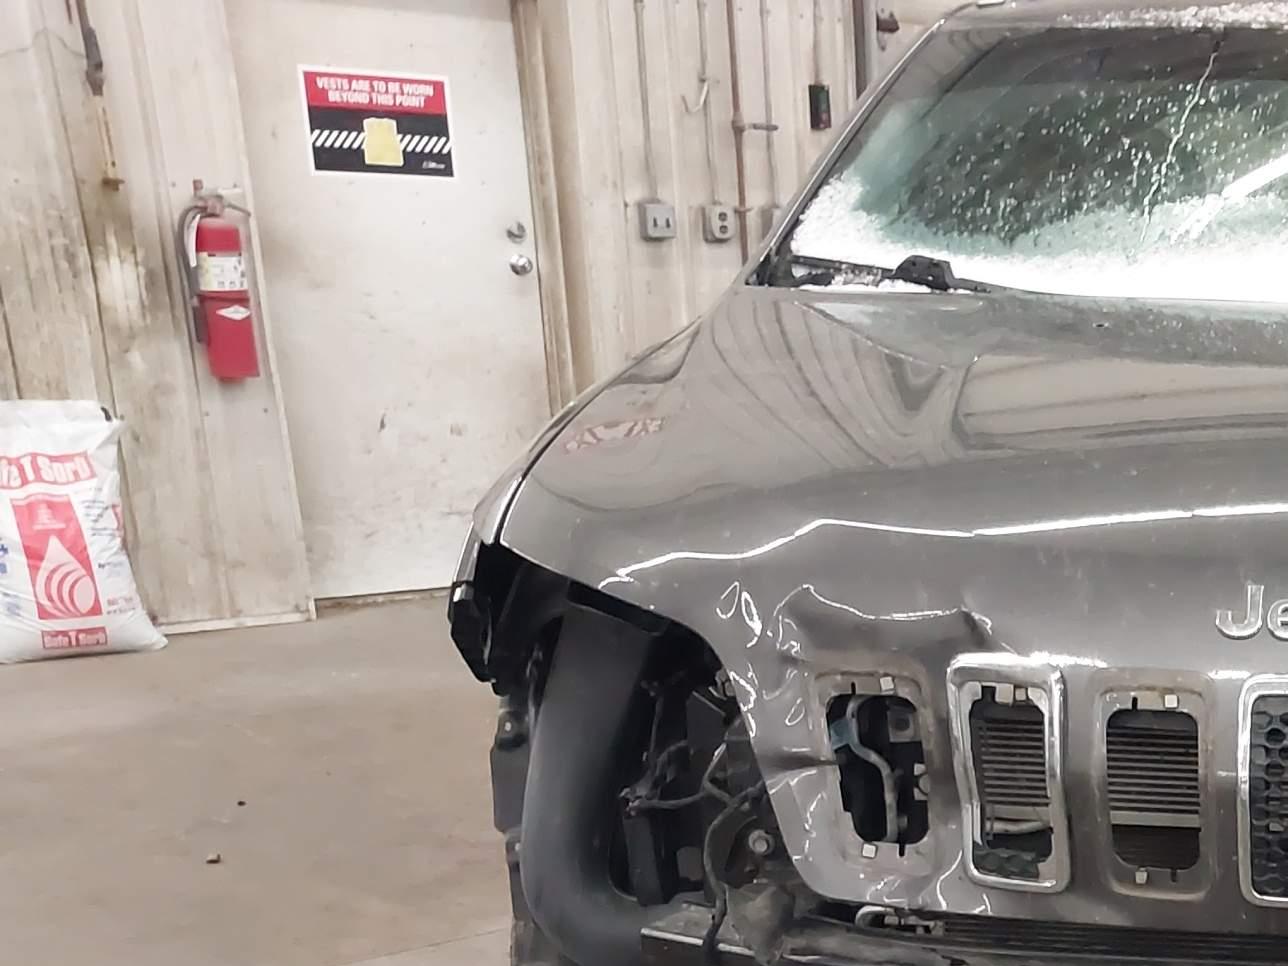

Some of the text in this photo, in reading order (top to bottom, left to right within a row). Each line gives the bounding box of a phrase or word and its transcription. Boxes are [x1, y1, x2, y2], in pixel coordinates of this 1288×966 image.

[316, 76, 433, 97] VESTS ARE TO BE WORN
[328, 90, 425, 108] BEYOND THIS POINT
